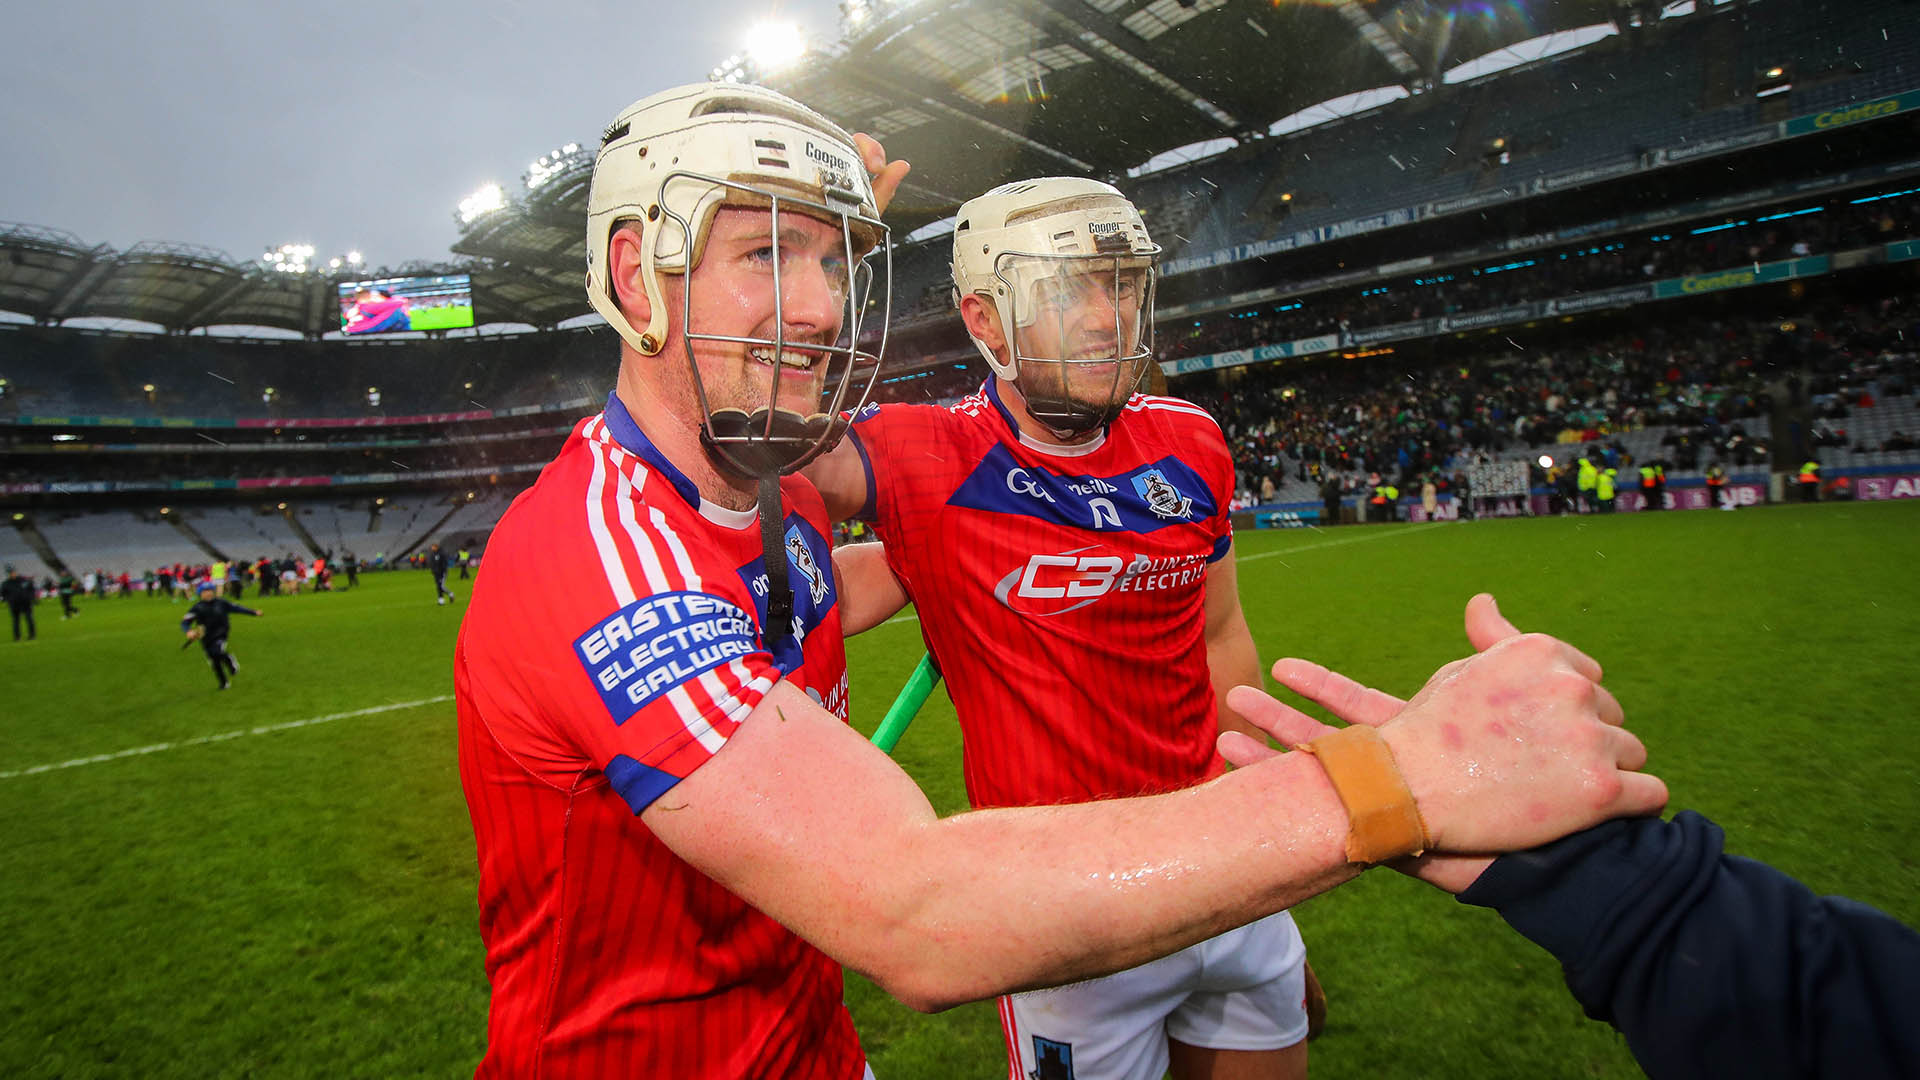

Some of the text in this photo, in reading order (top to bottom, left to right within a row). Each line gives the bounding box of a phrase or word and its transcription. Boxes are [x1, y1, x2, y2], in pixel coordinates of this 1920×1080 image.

[1814, 99, 1899, 129] Centra
[805, 141, 851, 170] Cooper
[1088, 222, 1121, 234] Cooper
[1329, 217, 1385, 239] Allianz
[1247, 237, 1295, 259] Allianz
[1169, 256, 1212, 277] Allianz
[1681, 270, 1755, 293] Centra
[1126, 556, 1181, 575] COLIN
[597, 617, 755, 692] ELECTRICAL
[626, 640, 755, 705] GALWAY
